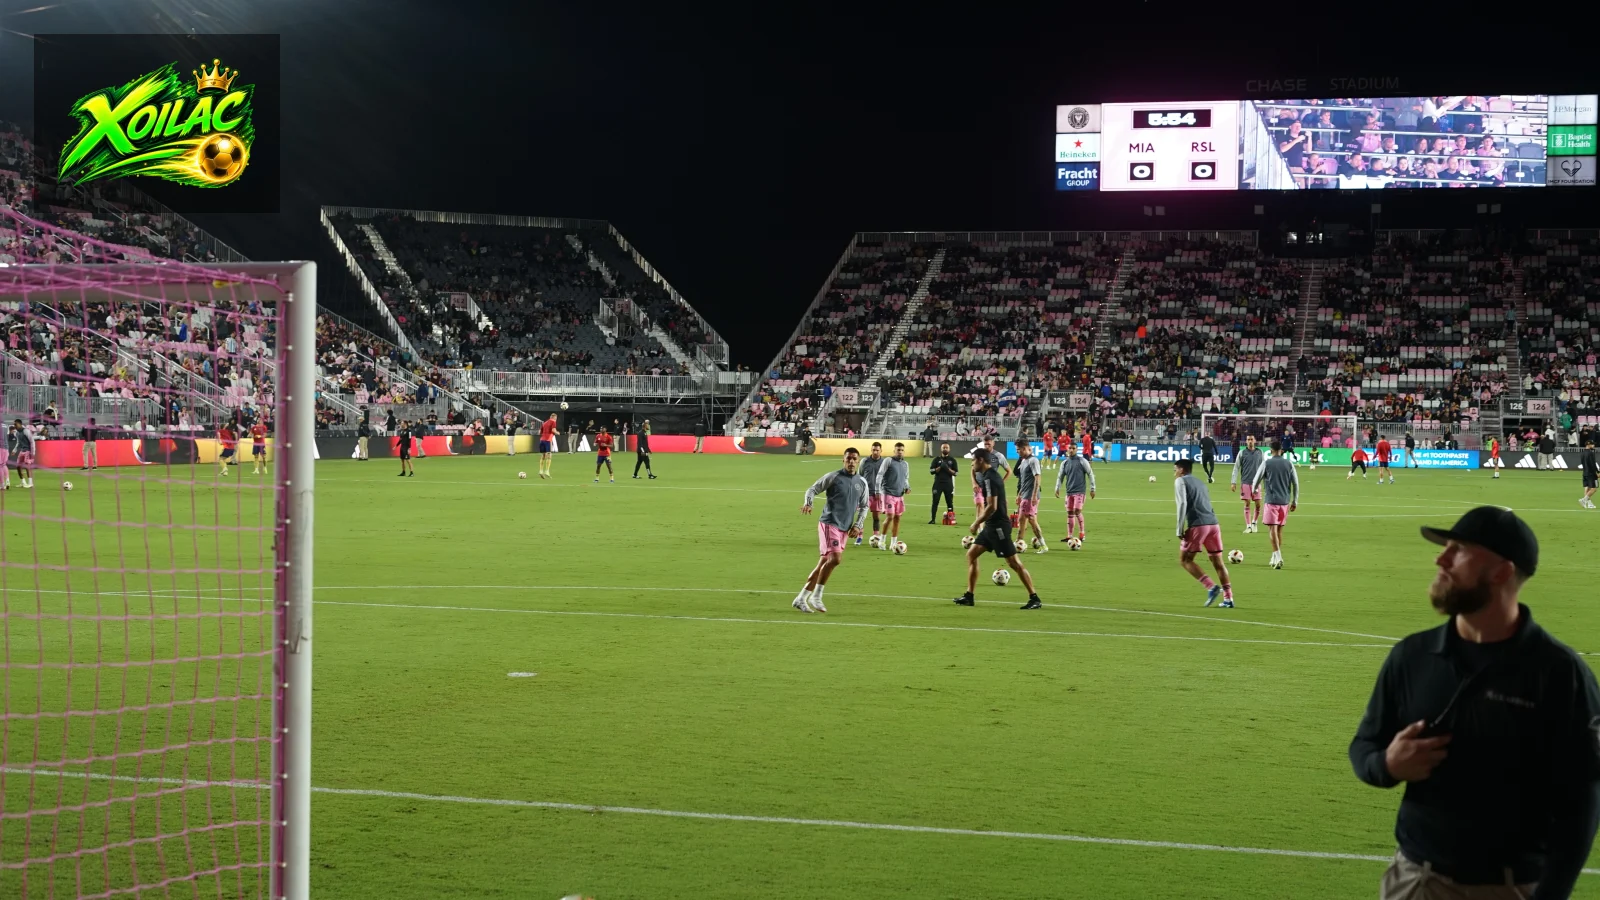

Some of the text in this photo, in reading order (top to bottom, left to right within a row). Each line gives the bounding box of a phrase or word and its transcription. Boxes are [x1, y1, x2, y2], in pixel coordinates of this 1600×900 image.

[1246, 77, 1400, 92] CHASE STADIUM
[1148, 112, 1197, 126] 5:54
[1568, 133, 1592, 141] Baptist
[1129, 143, 1155, 153] MIA
[1191, 142, 1216, 152] RSL
[1060, 151, 1097, 159] Heineken
[1057, 167, 1098, 179] Fracht
[1133, 165, 1151, 179] 0
[1194, 164, 1213, 178] 0
[1066, 179, 1090, 187] GROUP
[10, 371, 22, 380] 118
[1074, 397, 1087, 405] 124
[1275, 400, 1288, 408] 124
[1509, 402, 1524, 410] 125
[1532, 403, 1546, 411] 126
[1031, 445, 1104, 458] HAED
[1126, 446, 1231, 463] Fracht GUP
[1430, 452, 1469, 460] TOOTHPASTE
